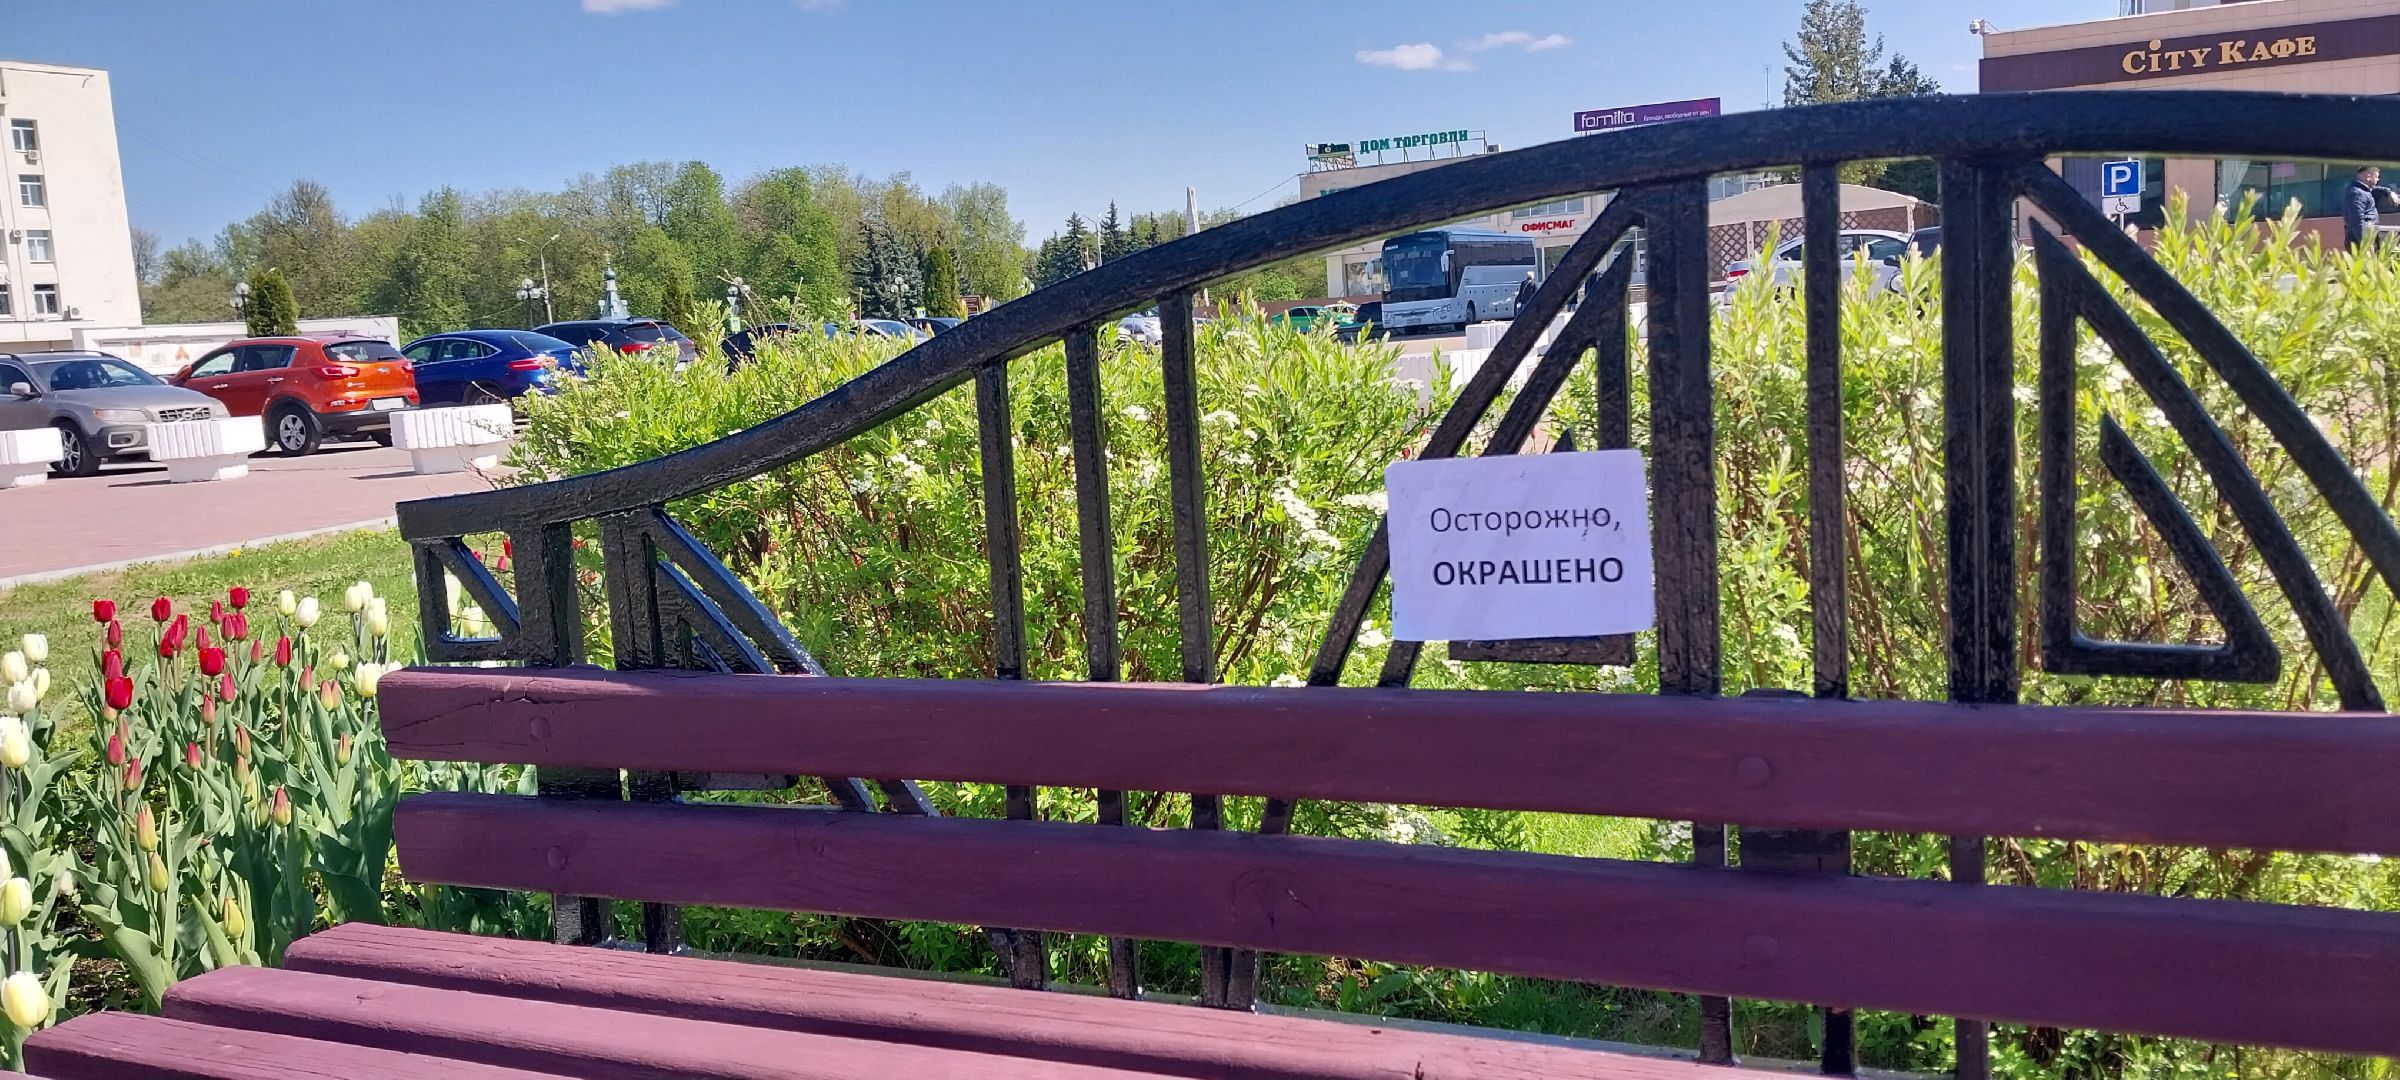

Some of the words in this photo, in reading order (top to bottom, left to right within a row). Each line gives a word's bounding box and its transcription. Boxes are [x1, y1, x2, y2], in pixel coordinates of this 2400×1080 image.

[2218, 36, 2316, 65] КАФЕ
[1581, 110, 1635, 128] familia
[1360, 139, 1390, 154] ДОМ
[1393, 130, 1468, 148] ТОРГОВЛИ
[1521, 219, 1575, 232] ОФИСМАГ
[1430, 507, 1621, 537] Осторожно,
[1433, 557, 1623, 586] ОКРАШЕНО
